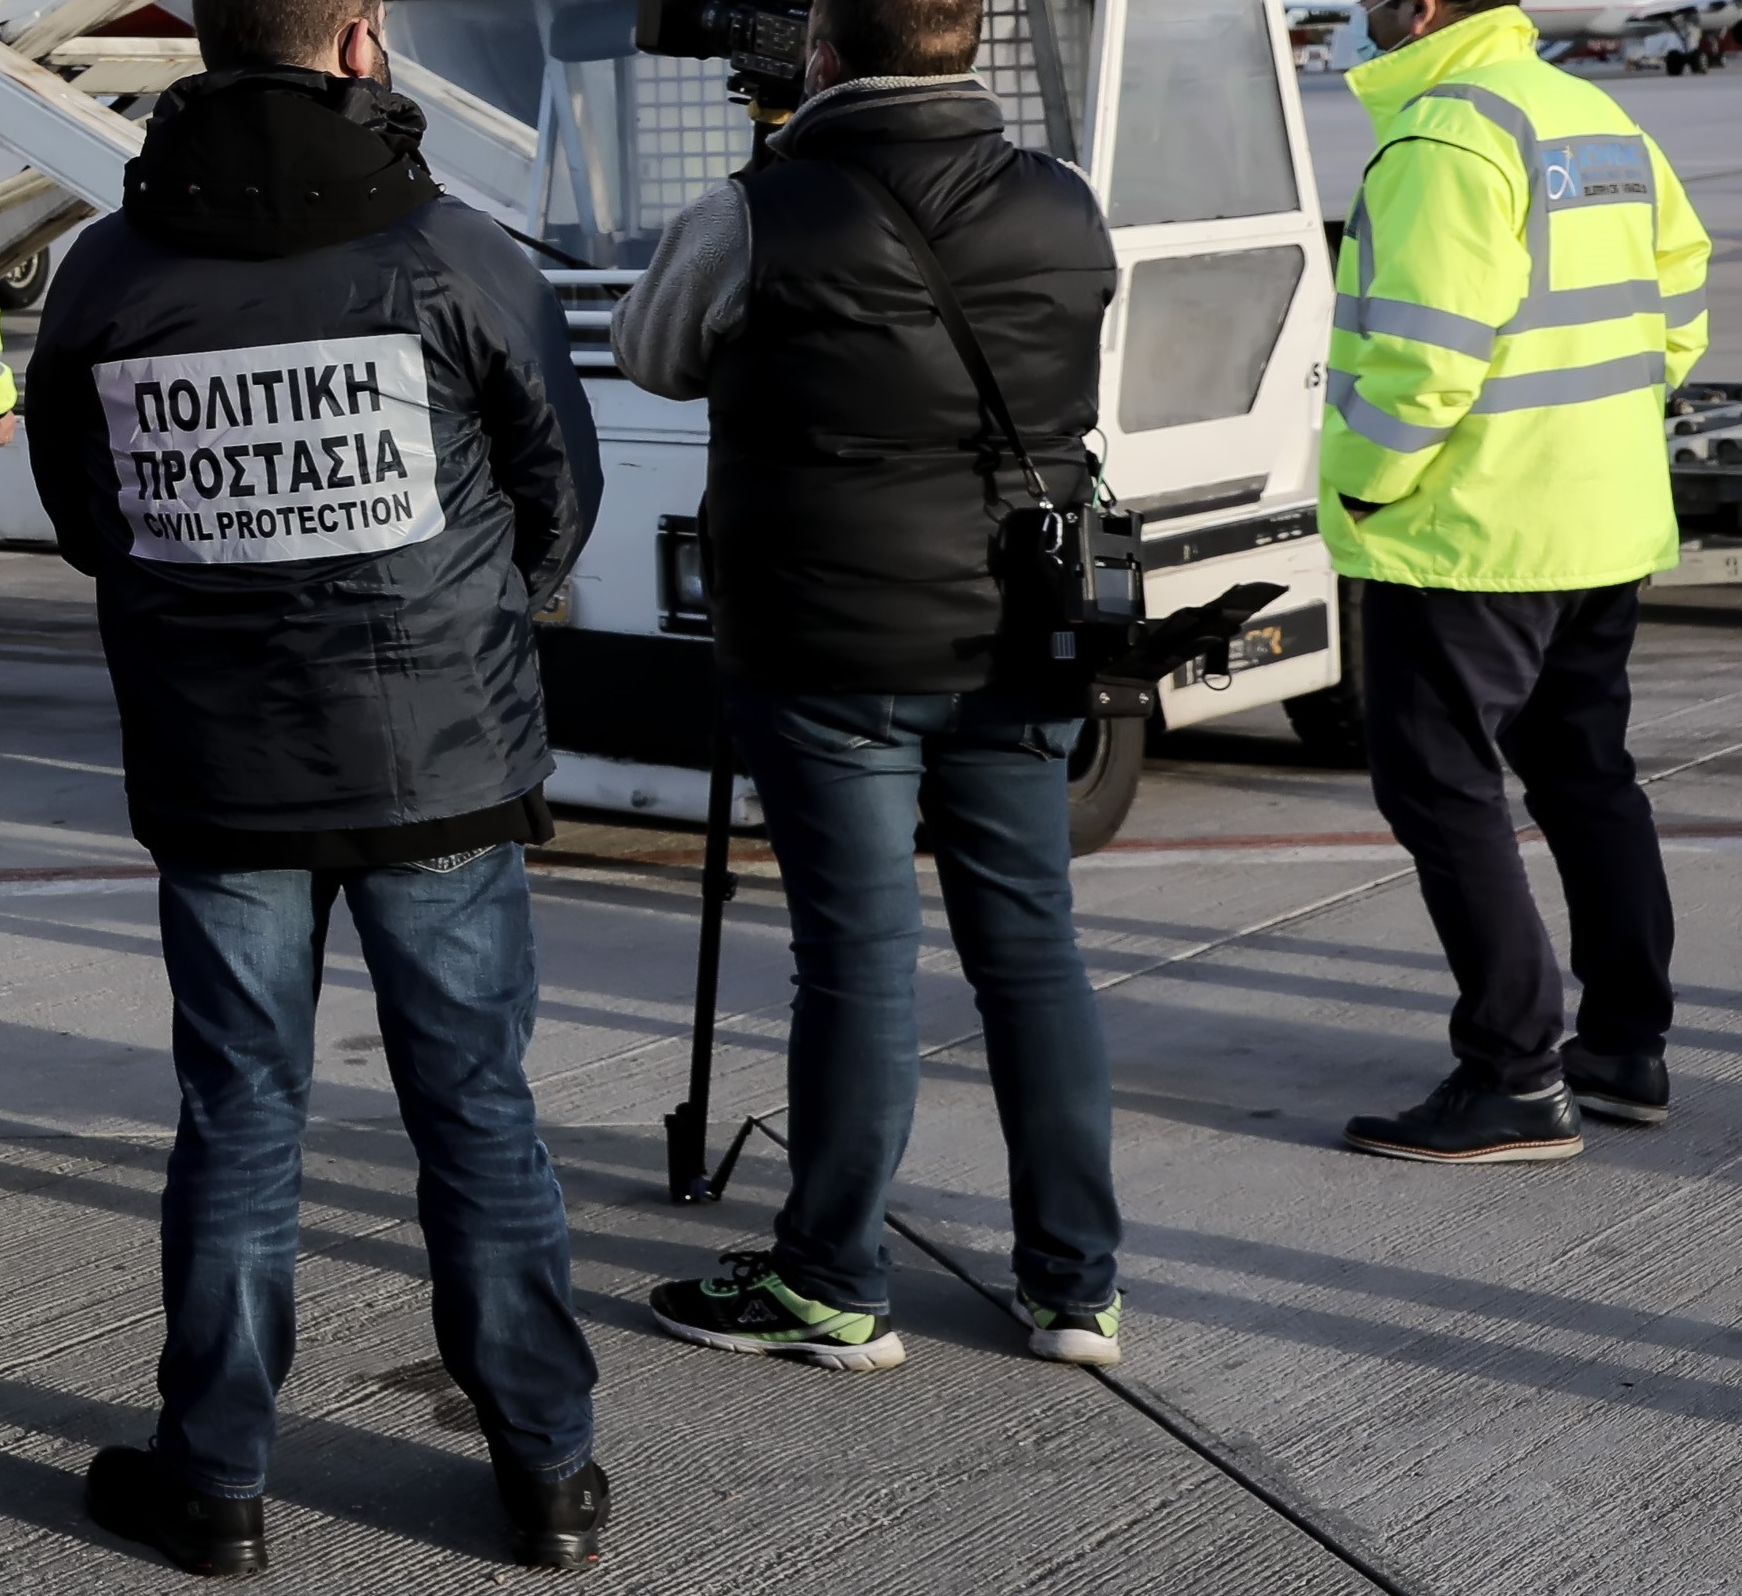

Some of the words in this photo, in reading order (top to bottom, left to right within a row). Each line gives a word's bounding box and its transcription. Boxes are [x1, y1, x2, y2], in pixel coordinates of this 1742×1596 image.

[134, 361, 381, 433] ΠΟΛΙΤΙΚΗ
[131, 429, 408, 500] ΠΡΟΣΤΑΣΙΑ
[143, 511, 213, 541] CIVIL
[216, 490, 413, 541] PROTECTION
